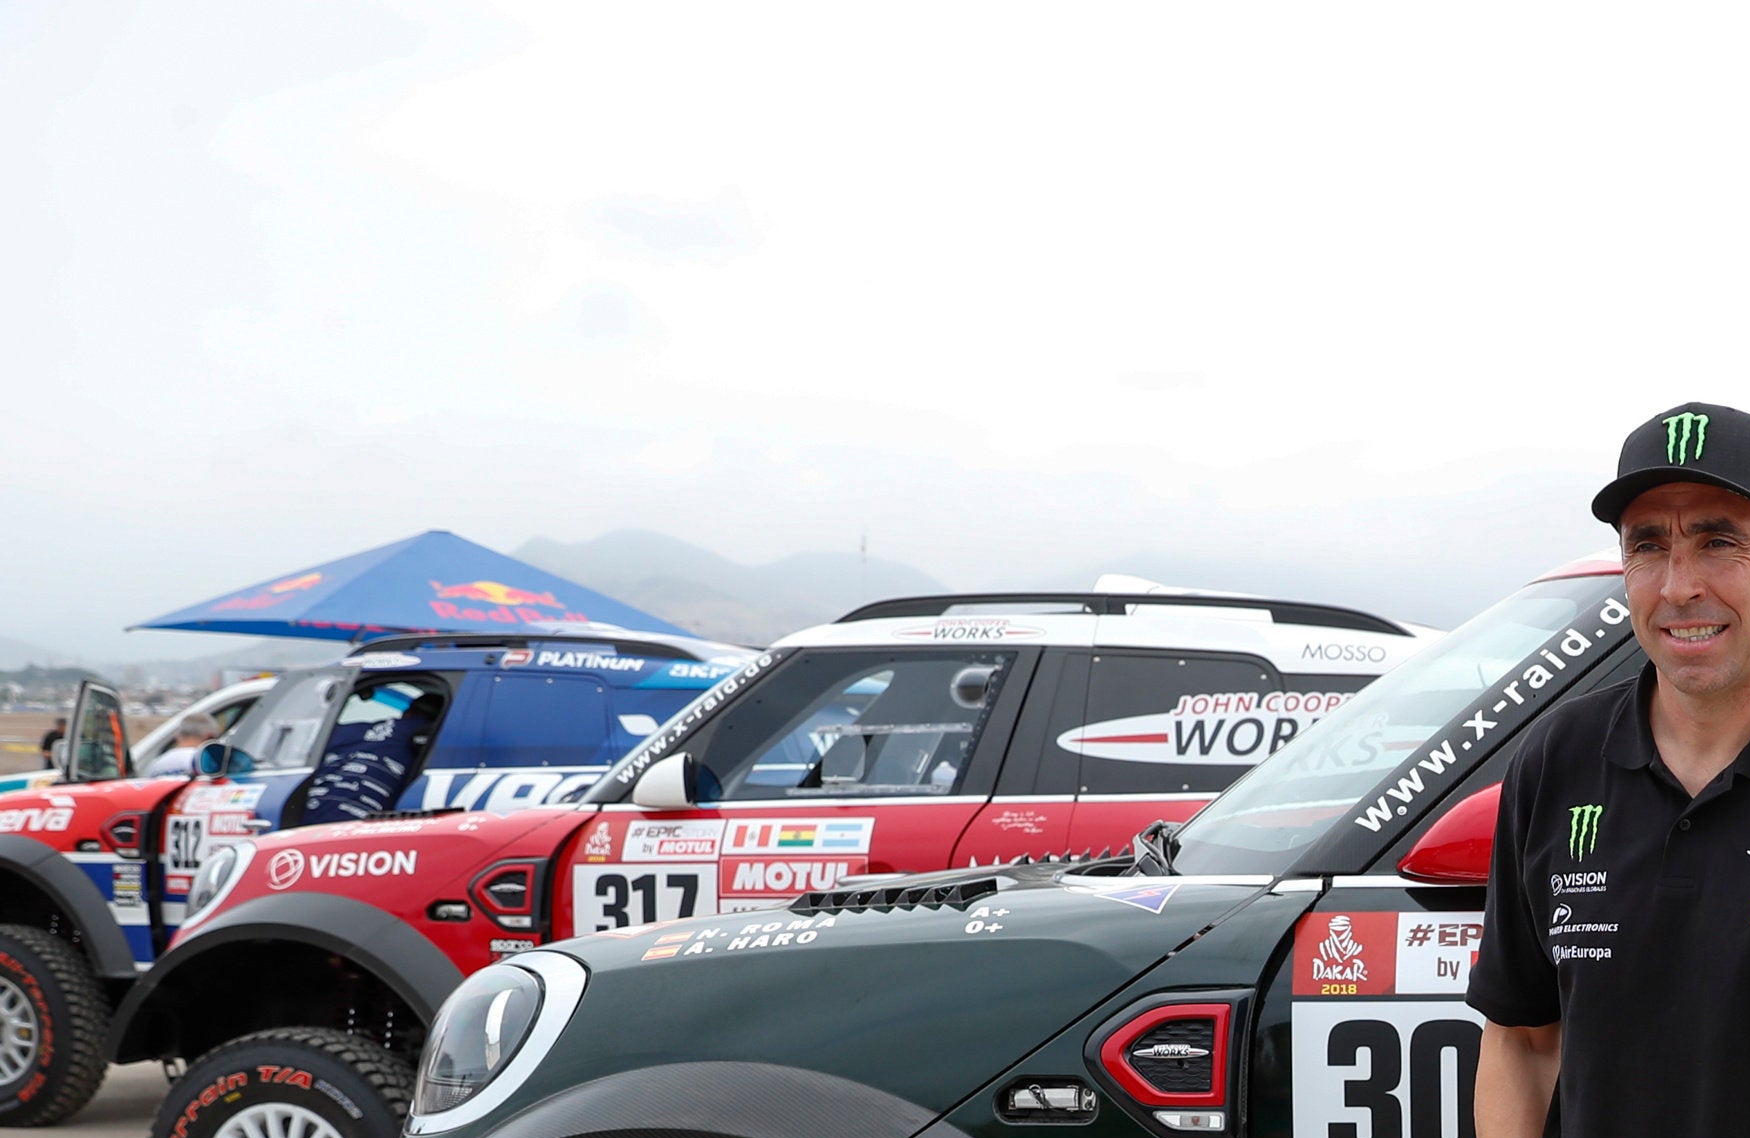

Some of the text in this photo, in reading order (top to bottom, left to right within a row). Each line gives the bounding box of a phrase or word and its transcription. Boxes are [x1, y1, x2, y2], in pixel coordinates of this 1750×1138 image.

[931, 626, 1007, 640] WORKS
[537, 652, 645, 671] PLATINUM
[1301, 643, 1386, 663] MOSSO
[1173, 695, 1254, 716] JOHN
[1354, 592, 1631, 834] www.x-raid.d
[171, 820, 202, 868] 312
[661, 841, 714, 853] MOTUL
[309, 850, 417, 879] VISION
[1563, 872, 1607, 886] VISION
[595, 874, 700, 932] 317
[969, 907, 1010, 918] A+
[744, 917, 837, 935] ROMA
[1563, 923, 1619, 933] ELECTRONICS
[727, 930, 819, 951] HARO
[1312, 958, 1368, 981] DAKAR
[1437, 957, 1461, 981] by
[1321, 984, 1358, 995] 2018
[1153, 1048, 1189, 1057] WORKS
[257, 1065, 314, 1090] T/A
